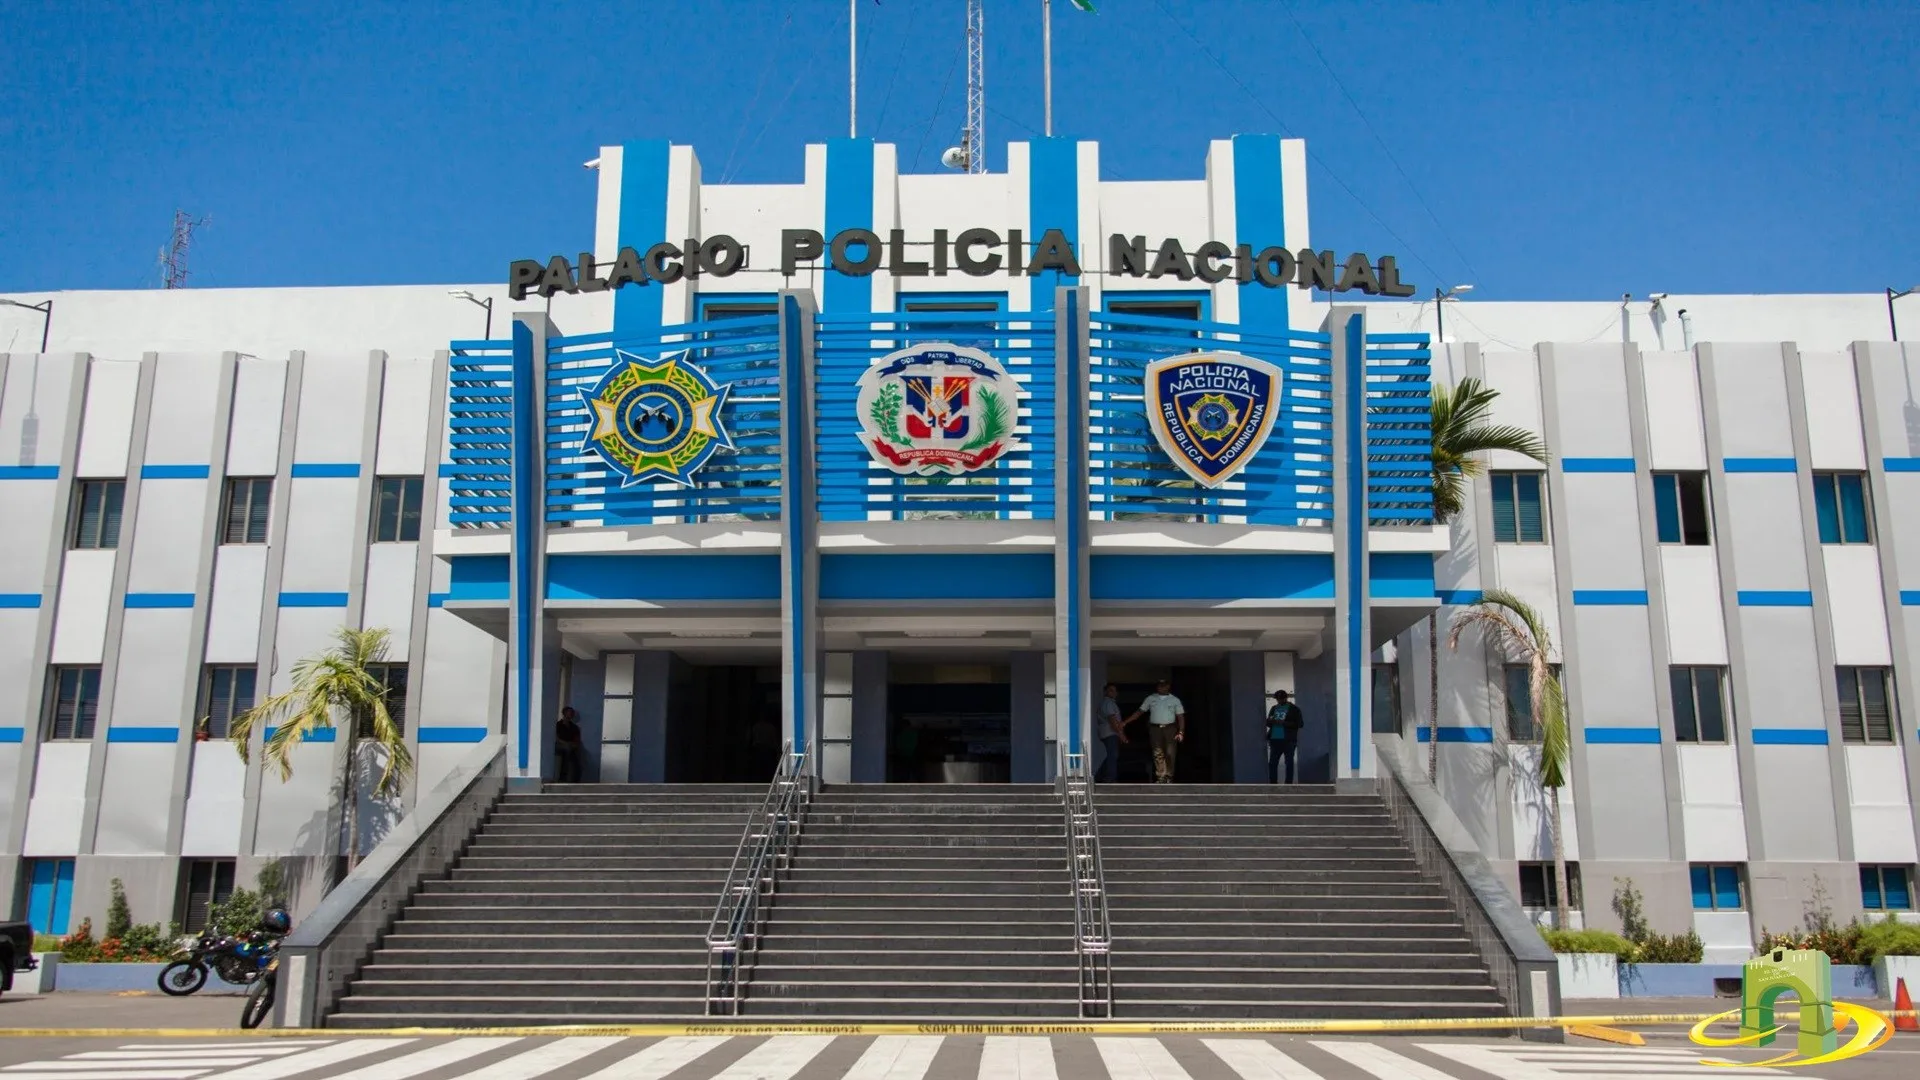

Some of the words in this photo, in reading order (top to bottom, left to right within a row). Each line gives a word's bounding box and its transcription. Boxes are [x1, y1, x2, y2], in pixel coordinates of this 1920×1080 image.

[509, 234, 745, 300] PALACIO
[781, 228, 1082, 277] POLICIA
[1109, 233, 1416, 298] NACIONAL
[1179, 365, 1250, 382] POLICIA
[1169, 377, 1260, 397] NACIONAL
[1163, 402, 1204, 464] REPUBLICA
[1219, 404, 1265, 465] DOMINICANA
[899, 450, 934, 459] REPUBLICA
[935, 450, 975, 462] DOMINICANA
